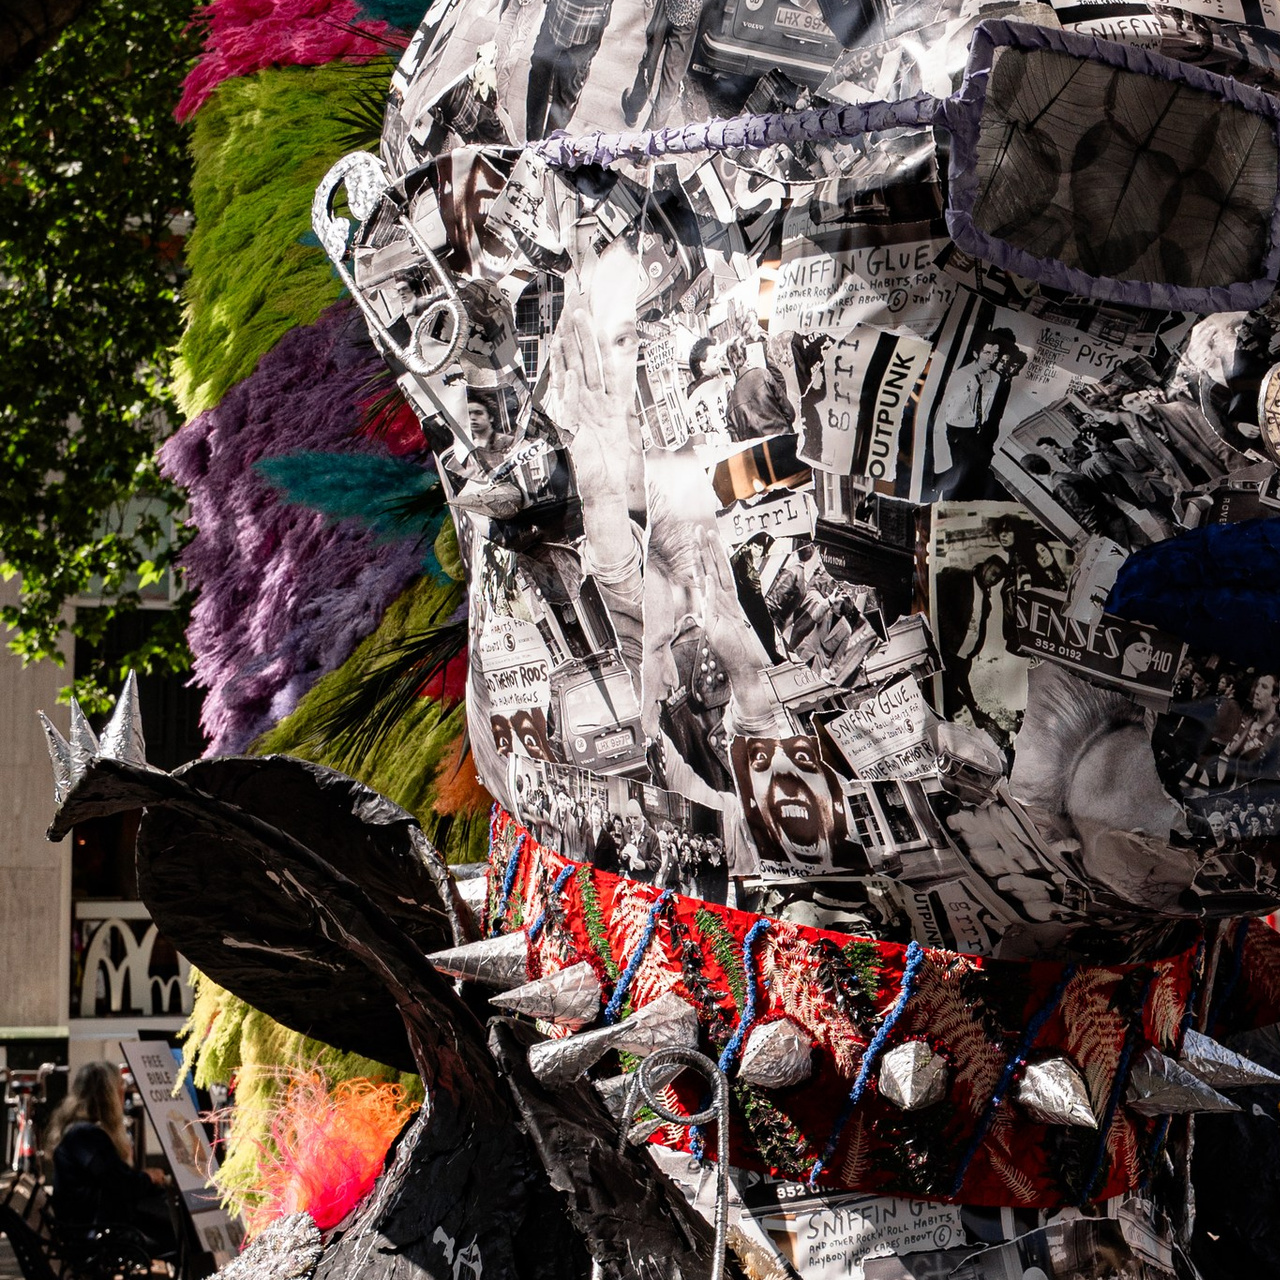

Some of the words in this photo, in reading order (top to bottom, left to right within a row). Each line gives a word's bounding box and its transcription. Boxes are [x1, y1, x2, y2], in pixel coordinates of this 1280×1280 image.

[742, 21, 765, 31] VOLVO
[776, 9, 801, 30] LHX
[789, 287, 813, 299] OTHER
[916, 272, 938, 285] FOR
[858, 292, 889, 305] ABOUT
[868, 351, 916, 480] OUTPUNK
[1034, 637, 1056, 653] 352
[1058, 646, 1083, 662] 0192
[1151, 649, 1174, 674] 410
[520, 664, 549, 689] RODS
[141, 1054, 164, 1069] FREE
[146, 1071, 173, 1086] BIBLE
[776, 1185, 806, 1199] 352
[808, 1249, 849, 1270] ANYBODY
[851, 1244, 871, 1258] WHO
[873, 1237, 901, 1256] CARES
[903, 1229, 933, 1246] ABOUT
[809, 1241, 827, 1256] AND
[829, 1234, 854, 1249] OTHER
